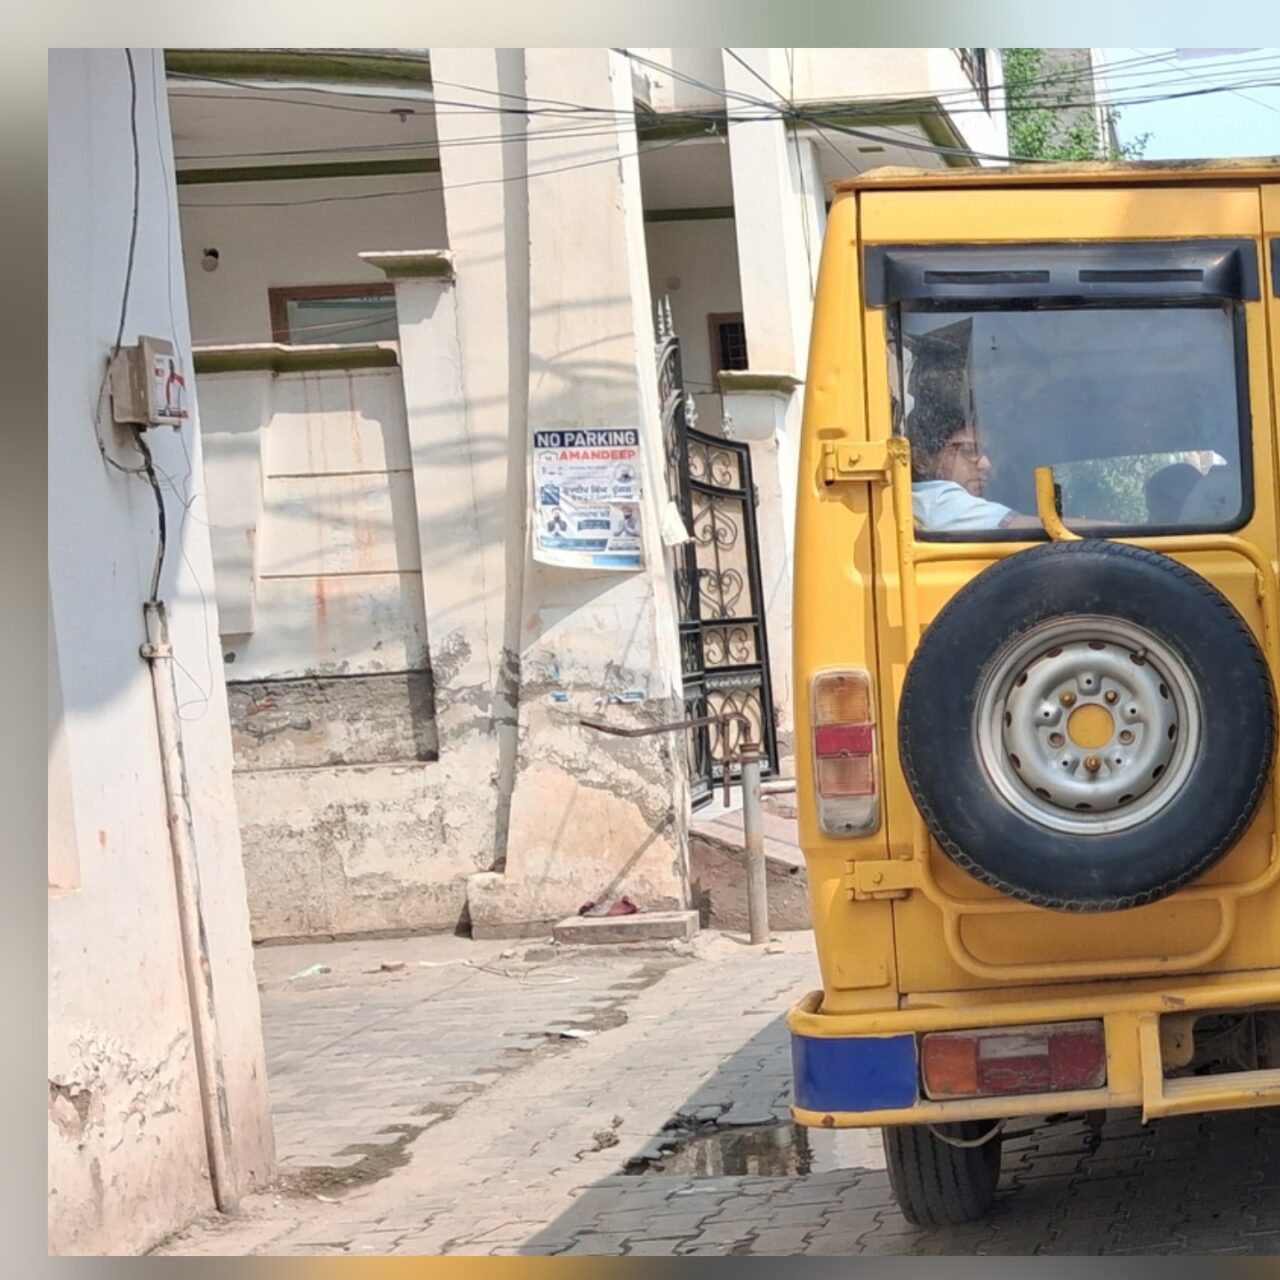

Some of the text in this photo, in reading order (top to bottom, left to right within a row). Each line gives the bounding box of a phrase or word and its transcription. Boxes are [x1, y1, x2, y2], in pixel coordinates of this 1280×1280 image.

[537, 430, 636, 447] NO PARKING
[559, 449, 636, 461] AMANDEEP
